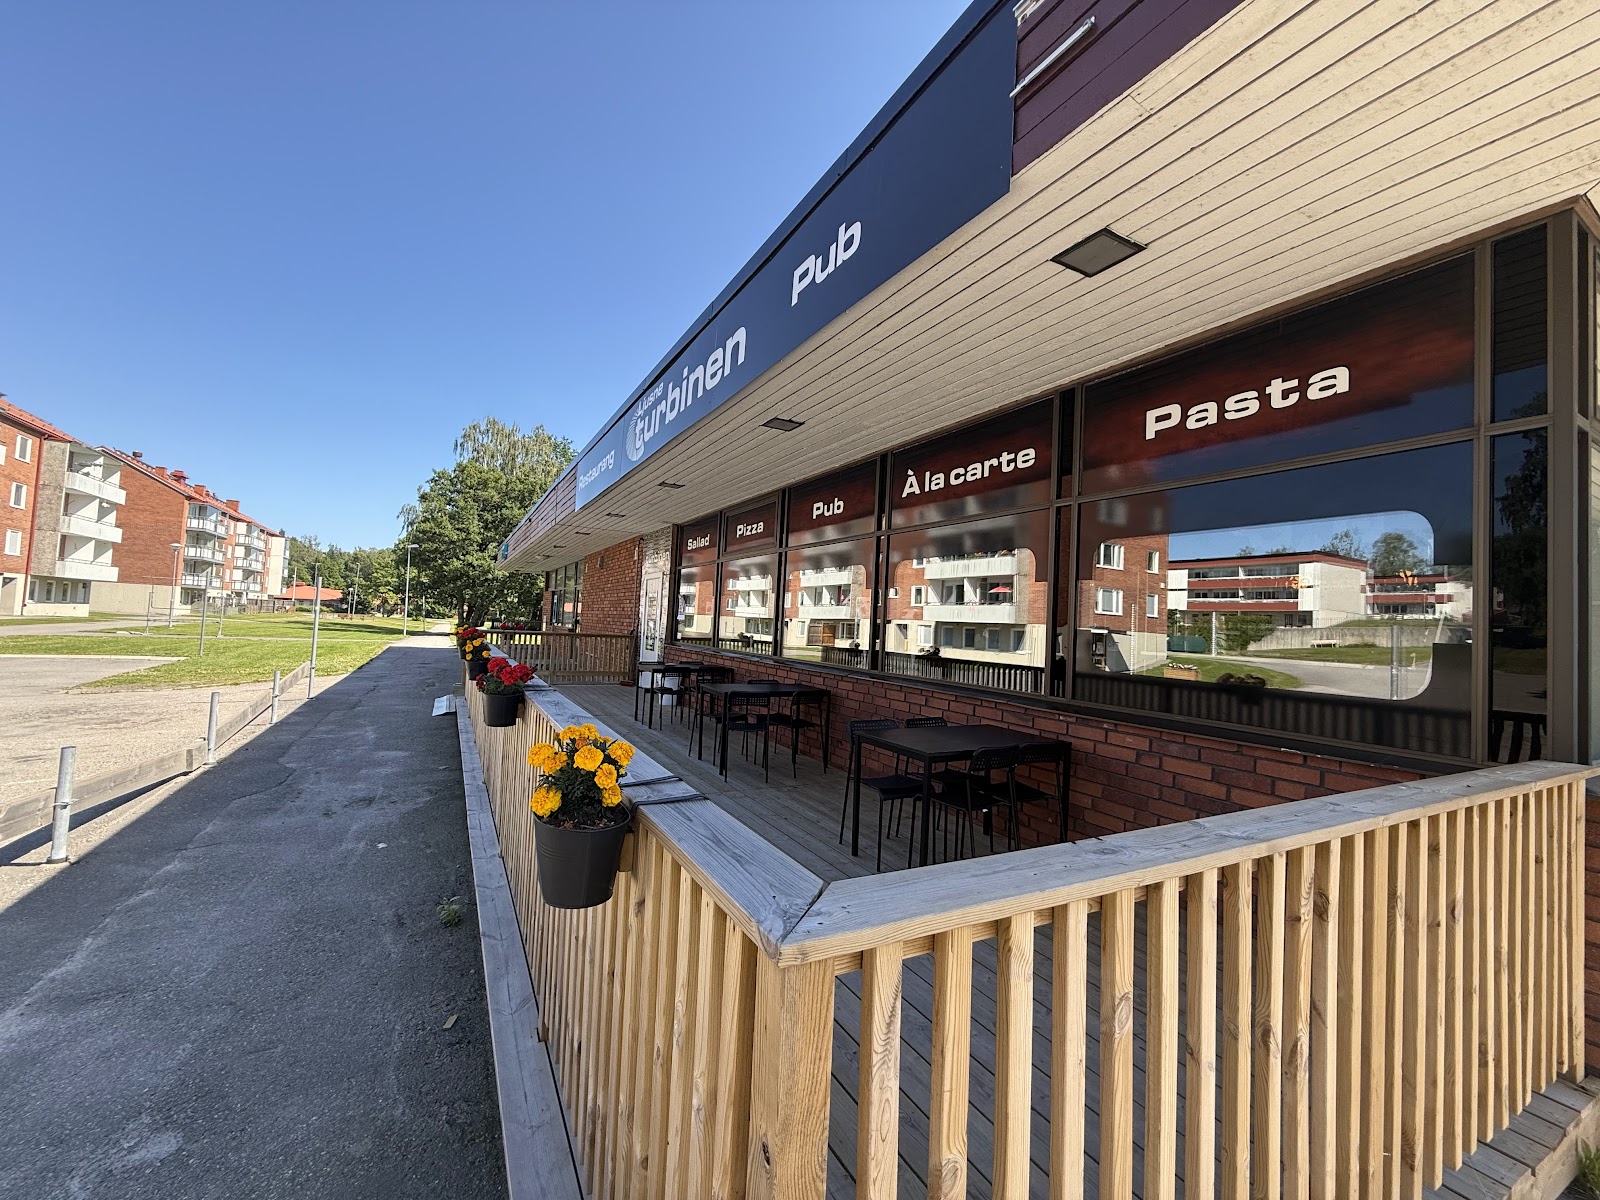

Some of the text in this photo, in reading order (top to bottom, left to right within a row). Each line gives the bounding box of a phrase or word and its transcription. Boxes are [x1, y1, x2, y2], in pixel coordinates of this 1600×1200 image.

[791, 221, 862, 306] Pub
[634, 326, 747, 449] turbinen
[637, 382, 664, 416] Ljusne
[1145, 366, 1351, 440] Pasta
[579, 450, 615, 489] Restaurang
[902, 447, 1036, 498] À la carte
[812, 498, 844, 519] Pub
[687, 534, 710, 550] Sallad
[736, 521, 764, 538] Pizza
